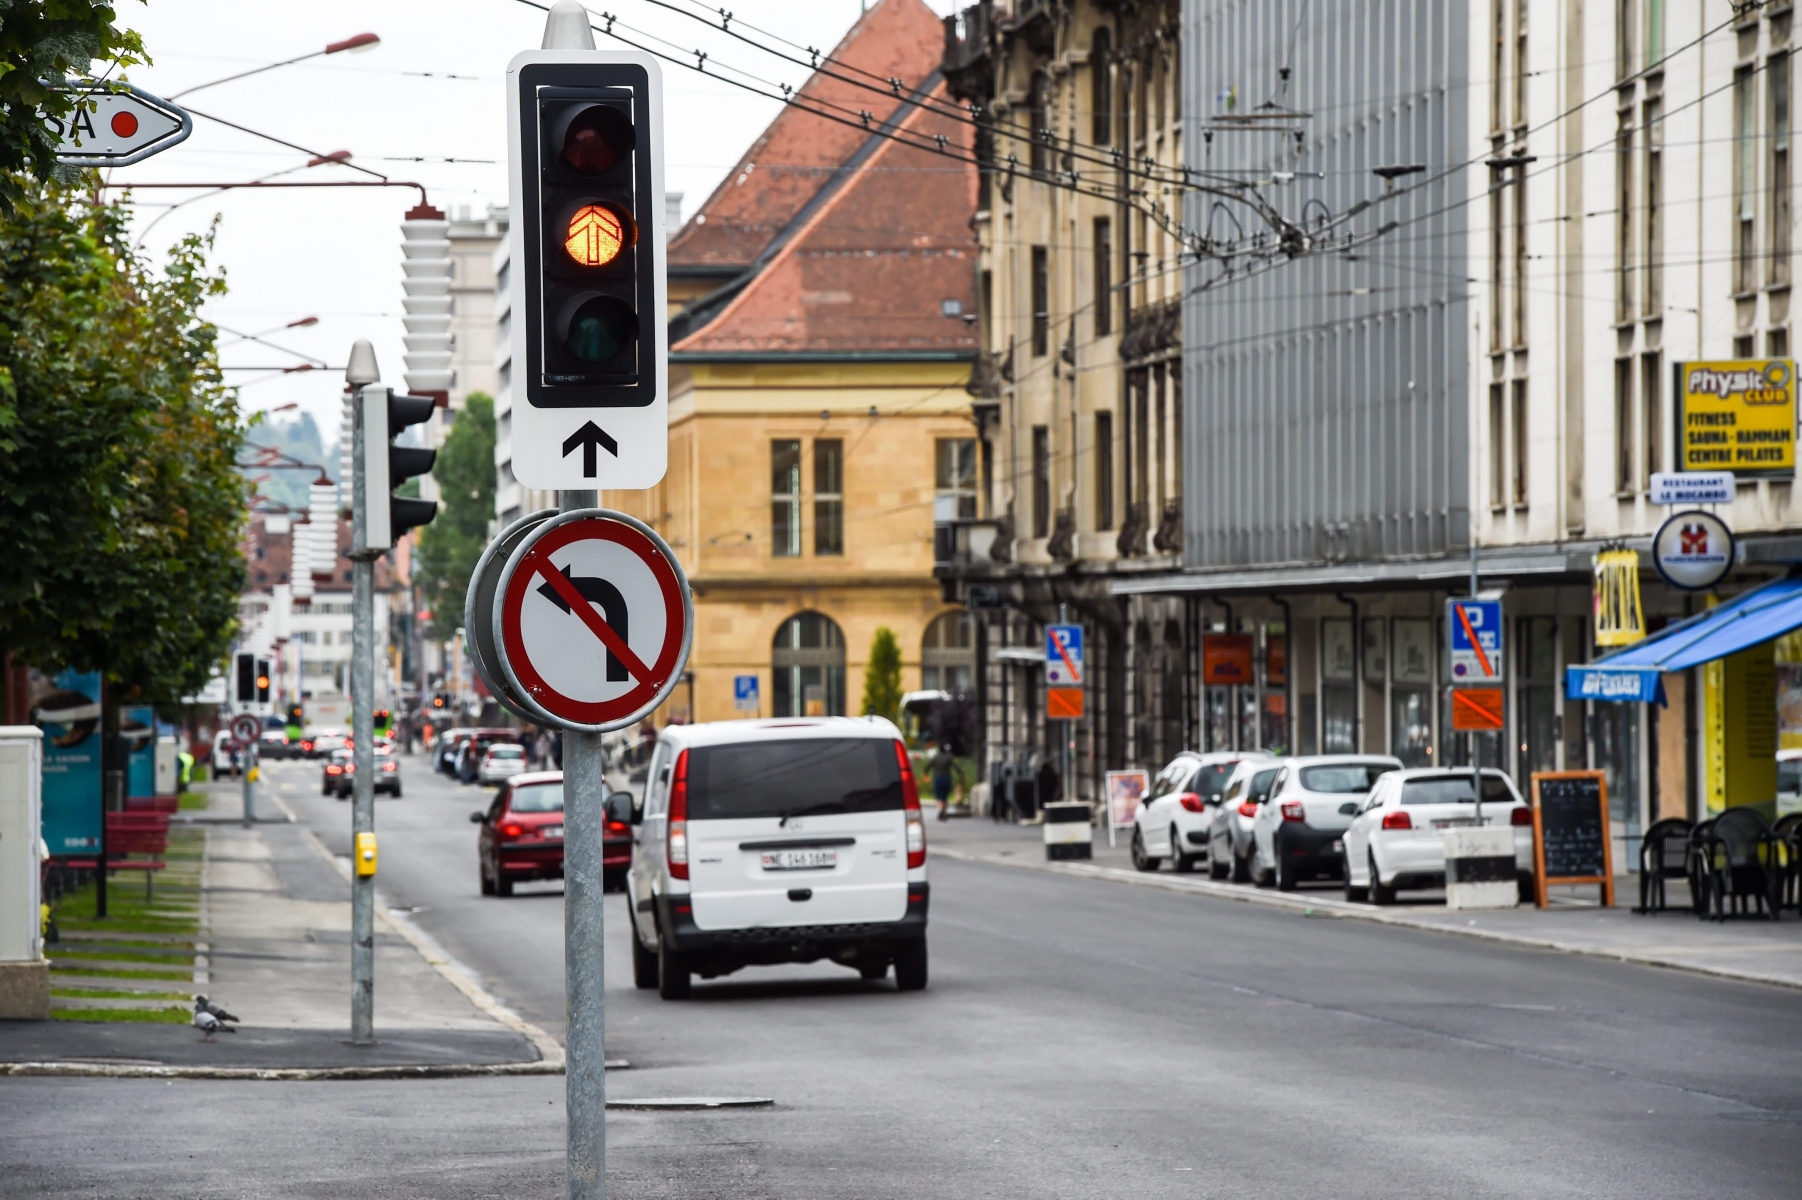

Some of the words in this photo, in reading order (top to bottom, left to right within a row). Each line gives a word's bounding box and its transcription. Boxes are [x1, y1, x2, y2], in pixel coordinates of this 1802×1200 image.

[1744, 388, 1787, 403] CLUB
[1688, 412, 1736, 426] FITNESS
[1689, 430, 1728, 445] SAUNA
[1736, 429, 1791, 444] HAMMAM
[1688, 448, 1732, 463] CENTRE
[1736, 447, 1784, 462] PILATES
[1662, 477, 1724, 487] RESTAURANT
[1660, 491, 1672, 500] LE
[1675, 490, 1727, 500] MOCAMBO
